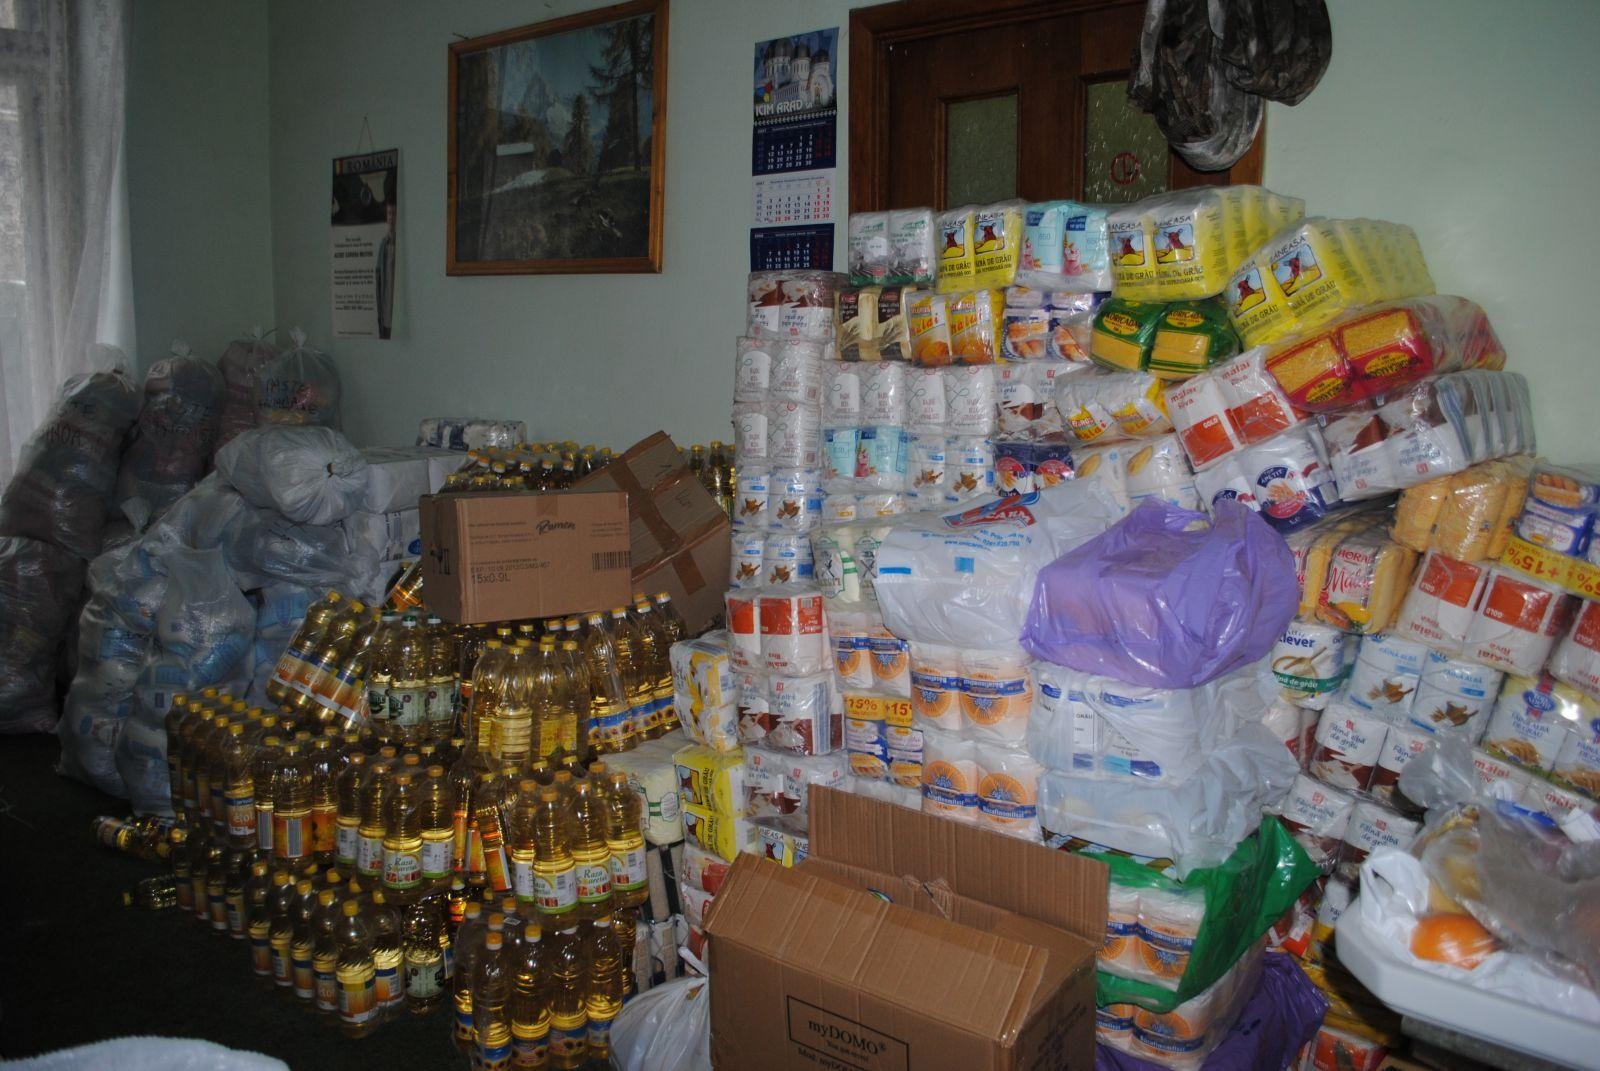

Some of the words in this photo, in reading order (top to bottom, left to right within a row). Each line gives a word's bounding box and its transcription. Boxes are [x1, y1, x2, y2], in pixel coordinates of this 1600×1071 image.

[756, 102, 774, 117] ICIM
[776, 99, 803, 113] ARAD
[1202, 417, 1219, 429] GOLD
[1486, 606, 1504, 618] GOLD
[584, 869, 603, 879] Raza
